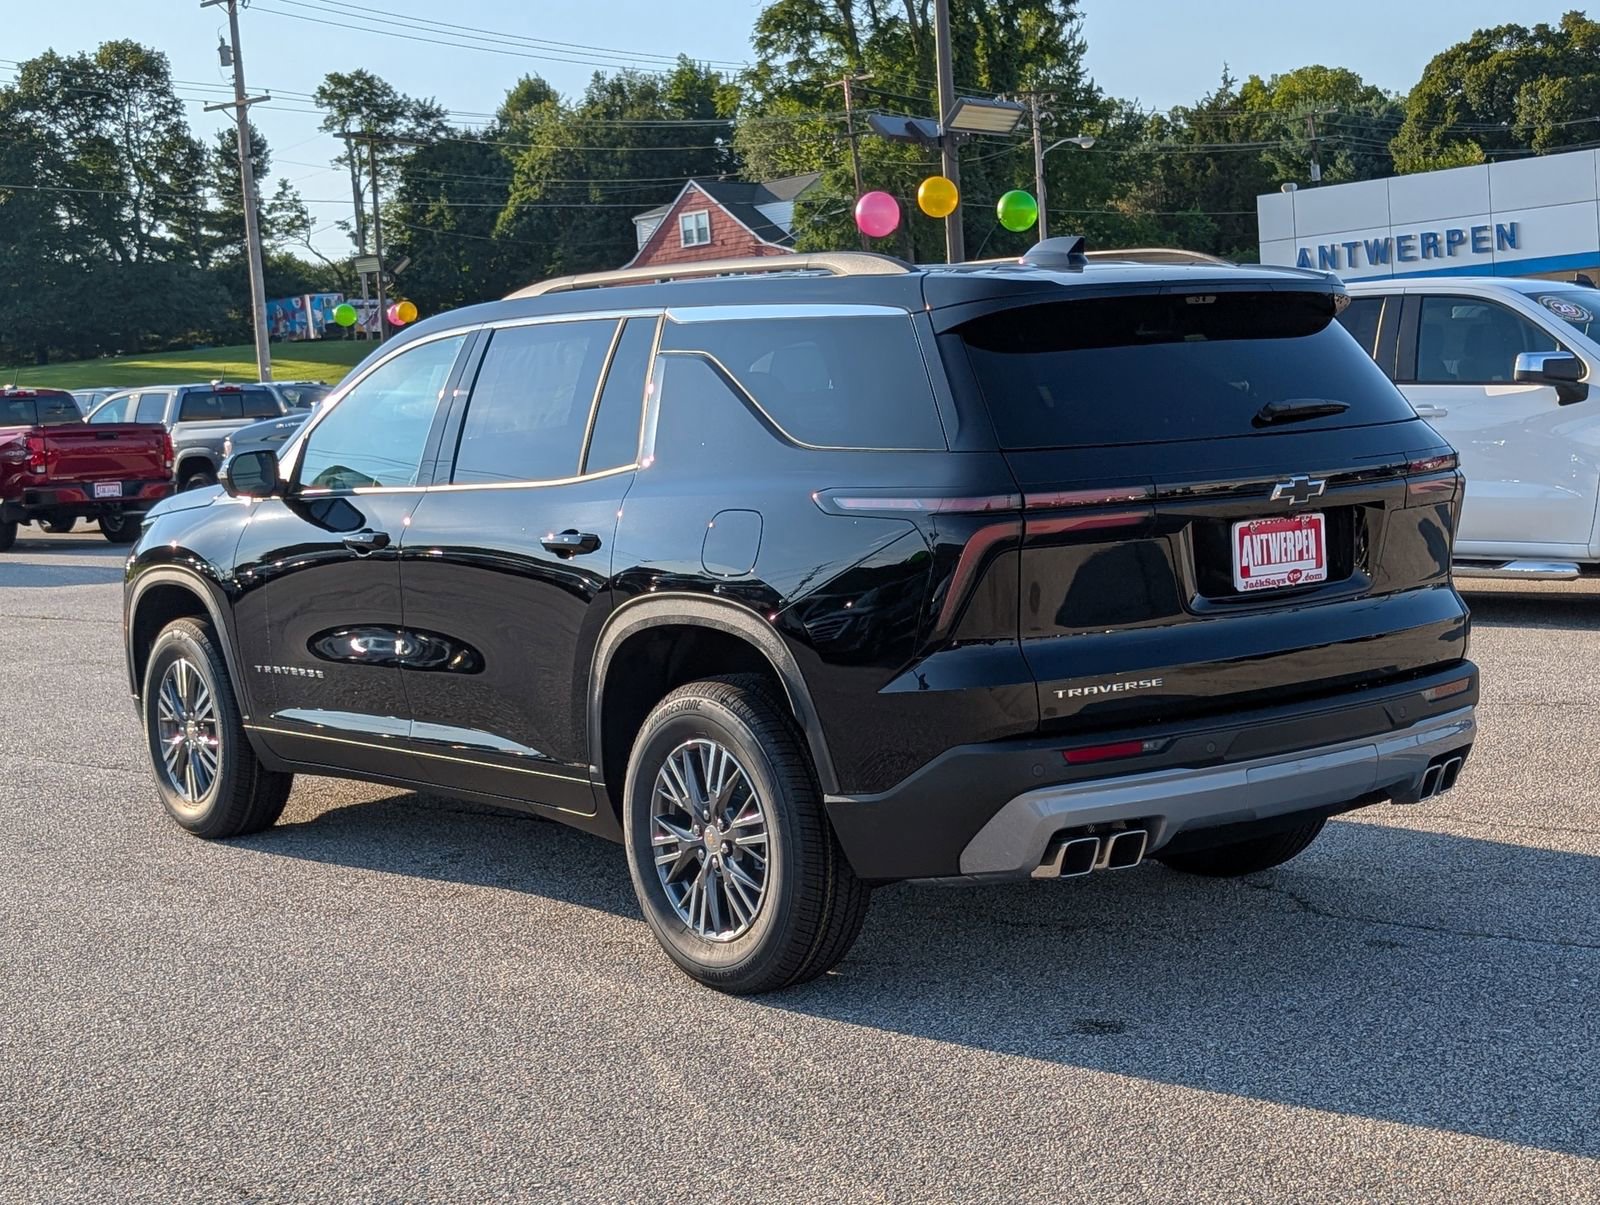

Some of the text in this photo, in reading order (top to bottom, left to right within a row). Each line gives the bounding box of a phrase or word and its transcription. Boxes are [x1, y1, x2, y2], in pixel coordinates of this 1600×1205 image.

[1296, 222, 1520, 270] ANTWERPEN
[1241, 528, 1316, 568] ANTWERPEN
[254, 664, 324, 679] TRAVERSE
[1053, 678, 1163, 699] TRAVERSE
